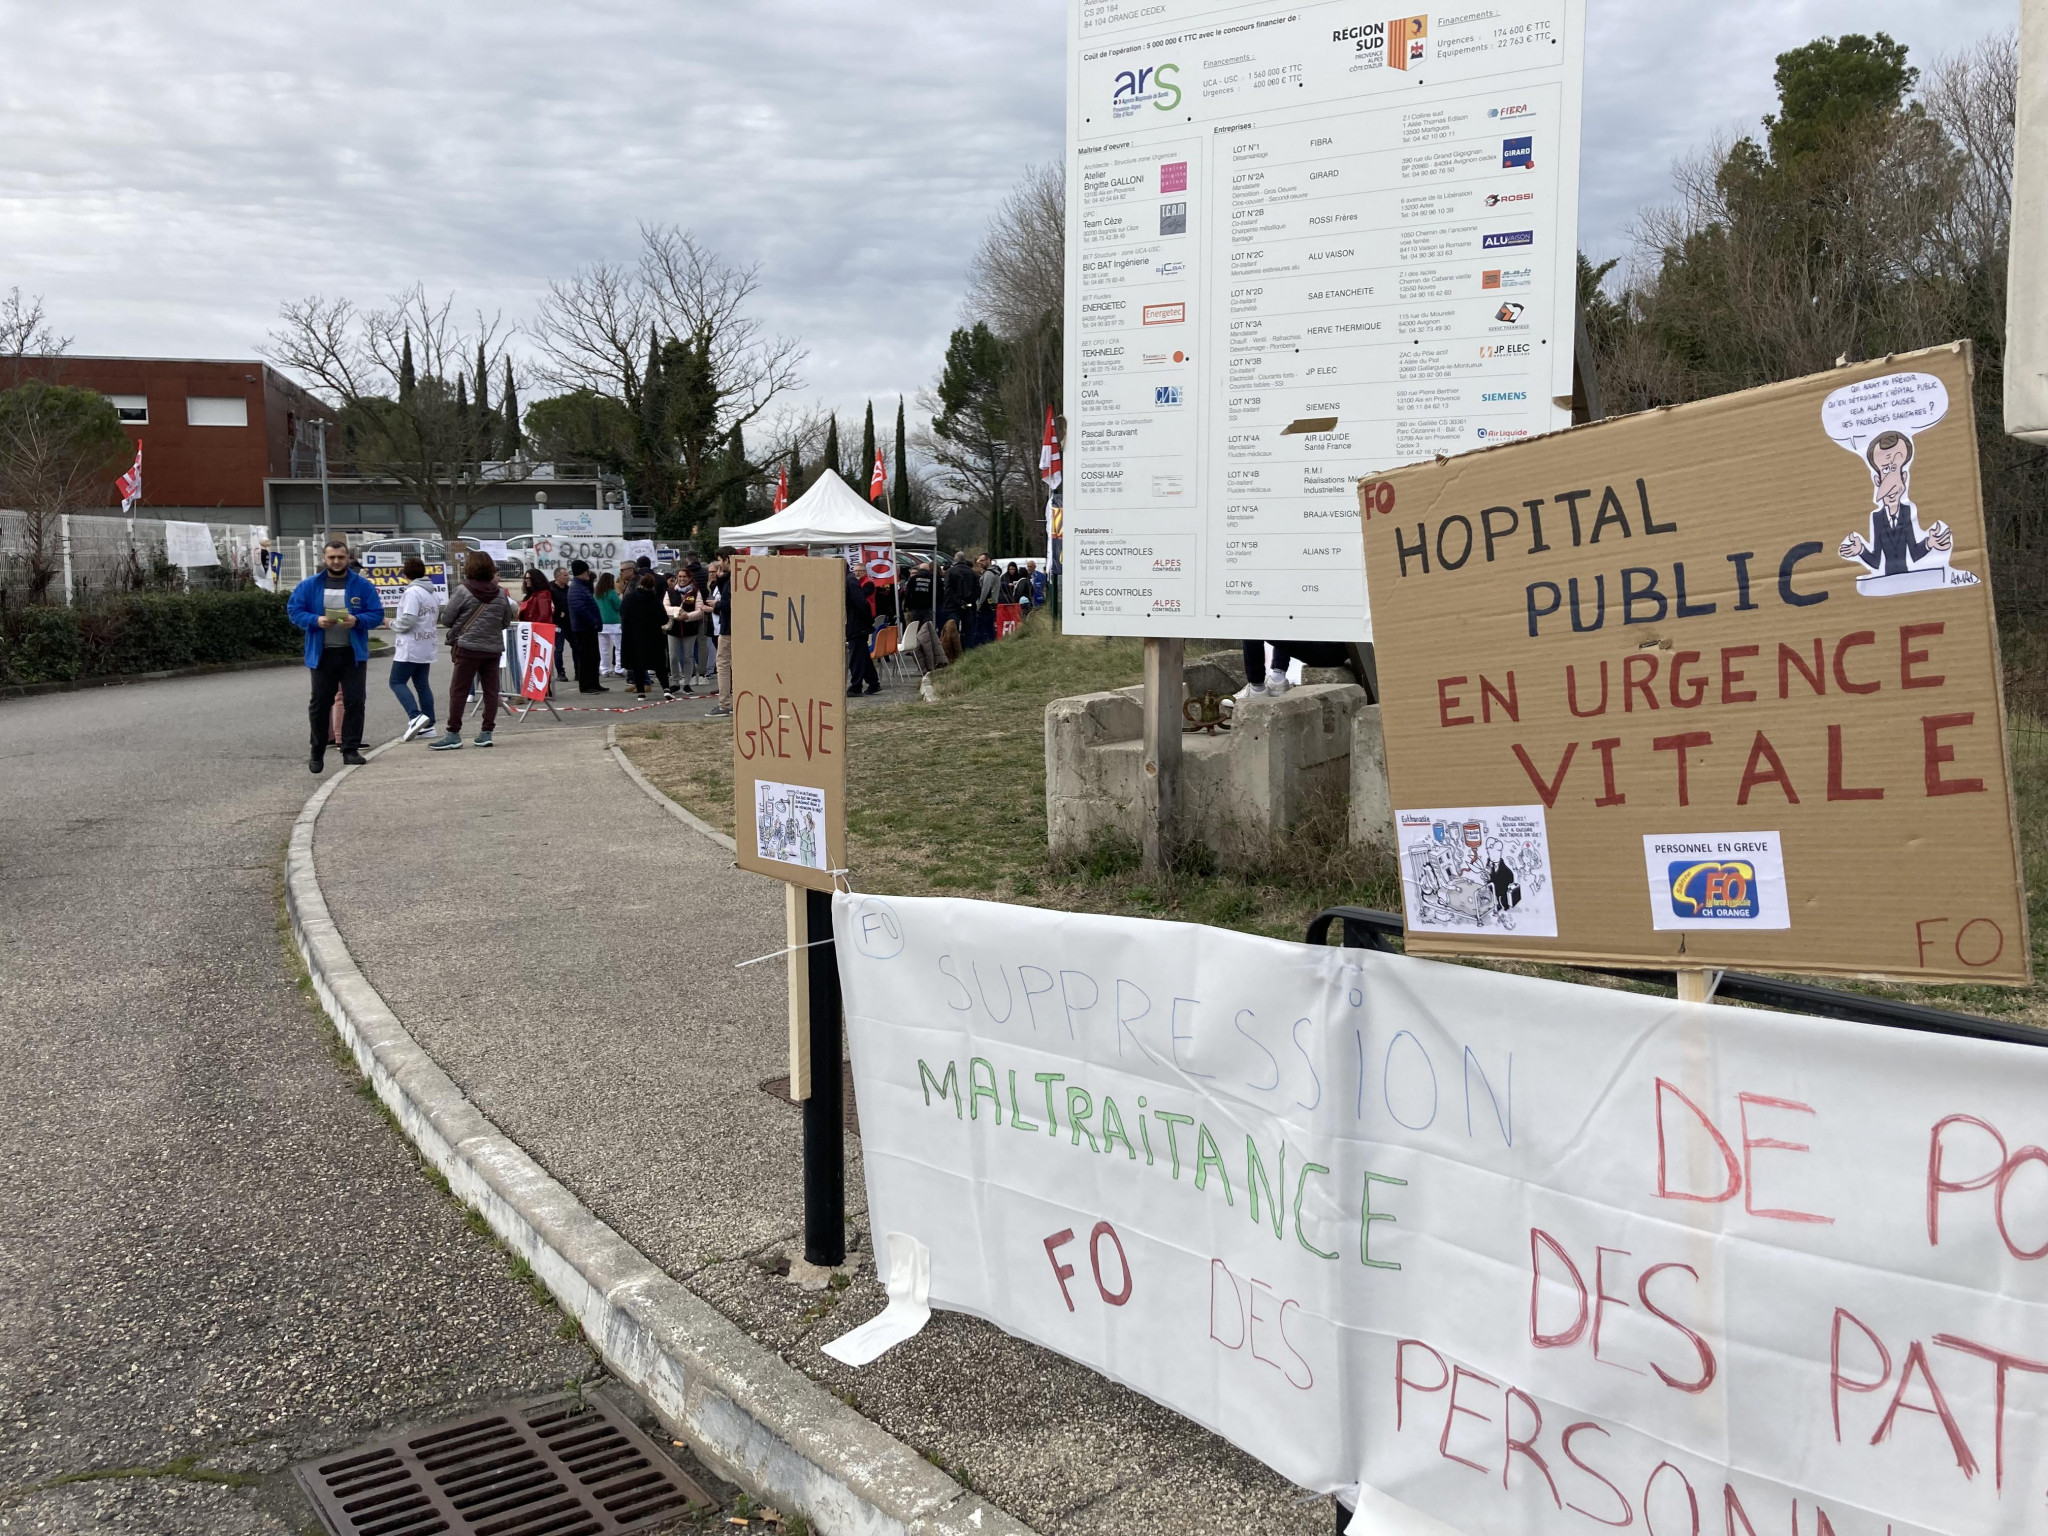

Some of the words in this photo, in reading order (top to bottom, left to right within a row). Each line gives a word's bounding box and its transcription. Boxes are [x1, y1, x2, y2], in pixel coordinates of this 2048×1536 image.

[1084, 20, 1093, 28] 84
[1094, 18, 1106, 27] 104
[1108, 11, 1138, 25] ORANGE
[1140, 5, 1166, 18] CEDEX
[1437, 10, 1493, 26] Financements
[1084, 52, 1098, 61] Coût
[1099, 50, 1108, 58] de
[1108, 45, 1141, 58] l'opération
[1147, 42, 1151, 50] 5
[1152, 40, 1164, 48] 000
[1166, 37, 1178, 46] 000
[1184, 33, 1198, 42] TTC
[1198, 31, 1214, 41] avec
[1216, 28, 1222, 36] le
[1224, 24, 1255, 36] concours
[1256, 17, 1286, 30] financier
[1288, 14, 1297, 24] de
[1332, 22, 1384, 42] RÉGION
[1437, 35, 1474, 48] Urgences
[1493, 28, 1508, 38] 174
[1509, 25, 1524, 36] 600
[1534, 20, 1551, 30] TTC
[1356, 36, 1384, 52] SUD
[1497, 39, 1508, 48] 22
[1509, 36, 1524, 46] 763
[1534, 32, 1551, 42] TTC
[1203, 53, 1250, 69] Financements
[1114, 63, 1182, 112] ars
[1500, 104, 1528, 116] FIBRA
[1214, 122, 1251, 134] Entreprises
[1078, 142, 1102, 154] Maîtrise
[1103, 140, 1130, 152] d'oeuvre
[1310, 137, 1332, 148] FIBRA
[1233, 144, 1247, 154] LOT
[1504, 147, 1530, 158] GIRARD
[1084, 170, 1107, 181] Atelier
[1232, 174, 1246, 183] LOT
[1310, 169, 1340, 180] GIRARD
[1084, 181, 1109, 193] Brigitte
[1110, 174, 1144, 188] GALLONI
[1500, 192, 1534, 203] ROSSI
[1084, 218, 1103, 229] Team
[1104, 216, 1122, 227] Cèze
[1309, 214, 1333, 225] ROSSI
[1335, 212, 1358, 222] Frères
[1484, 236, 1508, 248] ALU
[1508, 232, 1530, 242] VAISON
[1308, 251, 1324, 261] ALU
[1325, 249, 1355, 260] VAISON
[1083, 262, 1096, 272] BIC
[1098, 260, 1112, 270] BAT
[1114, 257, 1150, 270] Ingénierie
[1308, 291, 1324, 300] SAB
[1326, 286, 1374, 299] ETANCHEITE
[1082, 300, 1126, 313] ENERGETEC
[1146, 308, 1182, 320] Energetec
[1307, 324, 1333, 335] HERVE
[1335, 321, 1382, 334] THERMIQUE
[1082, 346, 1124, 358] TEKHNELEC
[1494, 345, 1504, 354] JP
[1508, 343, 1530, 353] ELEC
[1306, 366, 1315, 376] JP
[1317, 366, 1338, 376] ELEC
[1850, 384, 1861, 394] QUI
[1916, 380, 1938, 392] PUBLIC
[1082, 390, 1099, 400] CVIA
[1482, 391, 1528, 402] SIEMENS
[1306, 402, 1340, 412] SIEMENS
[1082, 429, 1104, 440] Pascal
[1106, 427, 1138, 438] Buravant
[1228, 434, 1244, 443] LOT
[1304, 433, 1318, 442] AIR
[1319, 432, 1350, 442] LIQUIDE
[1488, 430, 1499, 438] Air
[1500, 428, 1528, 438] Liquide
[1304, 442, 1325, 452] Santé
[1327, 442, 1352, 450] France
[1081, 470, 1124, 480] COSSI-MAP
[1304, 476, 1345, 484] Réalisations
[1304, 486, 1345, 494] Industrielles
[1363, 481, 1396, 520] FO
[1395, 476, 1678, 579] HOPITAL
[534, 539, 552, 557] FO
[560, 542, 616, 560] 2020
[1080, 548, 1104, 556] ALPES
[1106, 547, 1153, 556] CONTROLES
[1302, 548, 1330, 556] ALIANS
[1332, 547, 1342, 555] TP
[1152, 559, 1182, 568] ALPES
[734, 559, 760, 593] FO
[1226, 580, 1240, 588] LOT
[1302, 585, 1319, 594] OTIS
[1524, 540, 1830, 638] PUBLIC
[1080, 588, 1104, 597] ALPES
[1106, 588, 1152, 597] CONTROLES
[1152, 599, 1181, 608] ALPES
[760, 590, 806, 644] EN
[532, 631, 553, 692] FO
[1436, 669, 1520, 728] EN
[1565, 621, 1946, 719] URGENCE
[736, 672, 834, 762] GRÈVE
[1511, 710, 1988, 810] VITALE
[1654, 843, 1712, 854] PERSONNEL
[1718, 842, 1731, 852] EN
[1734, 842, 1768, 852] GREVE
[1706, 871, 1747, 903] FO
[1702, 908, 1714, 917] CH
[1716, 908, 1750, 918] ORANGE
[860, 911, 900, 945] FO
[1914, 916, 2003, 969] FO
[937, 954, 1513, 1149] SUPPRESSION
[1650, 1075, 1836, 1226] DE
[917, 1056, 1409, 1270] MALTRAITANCE
[1529, 1226, 1717, 1394] DES
[1043, 1220, 1133, 1313] FO
[1209, 1257, 1313, 1391] DES
